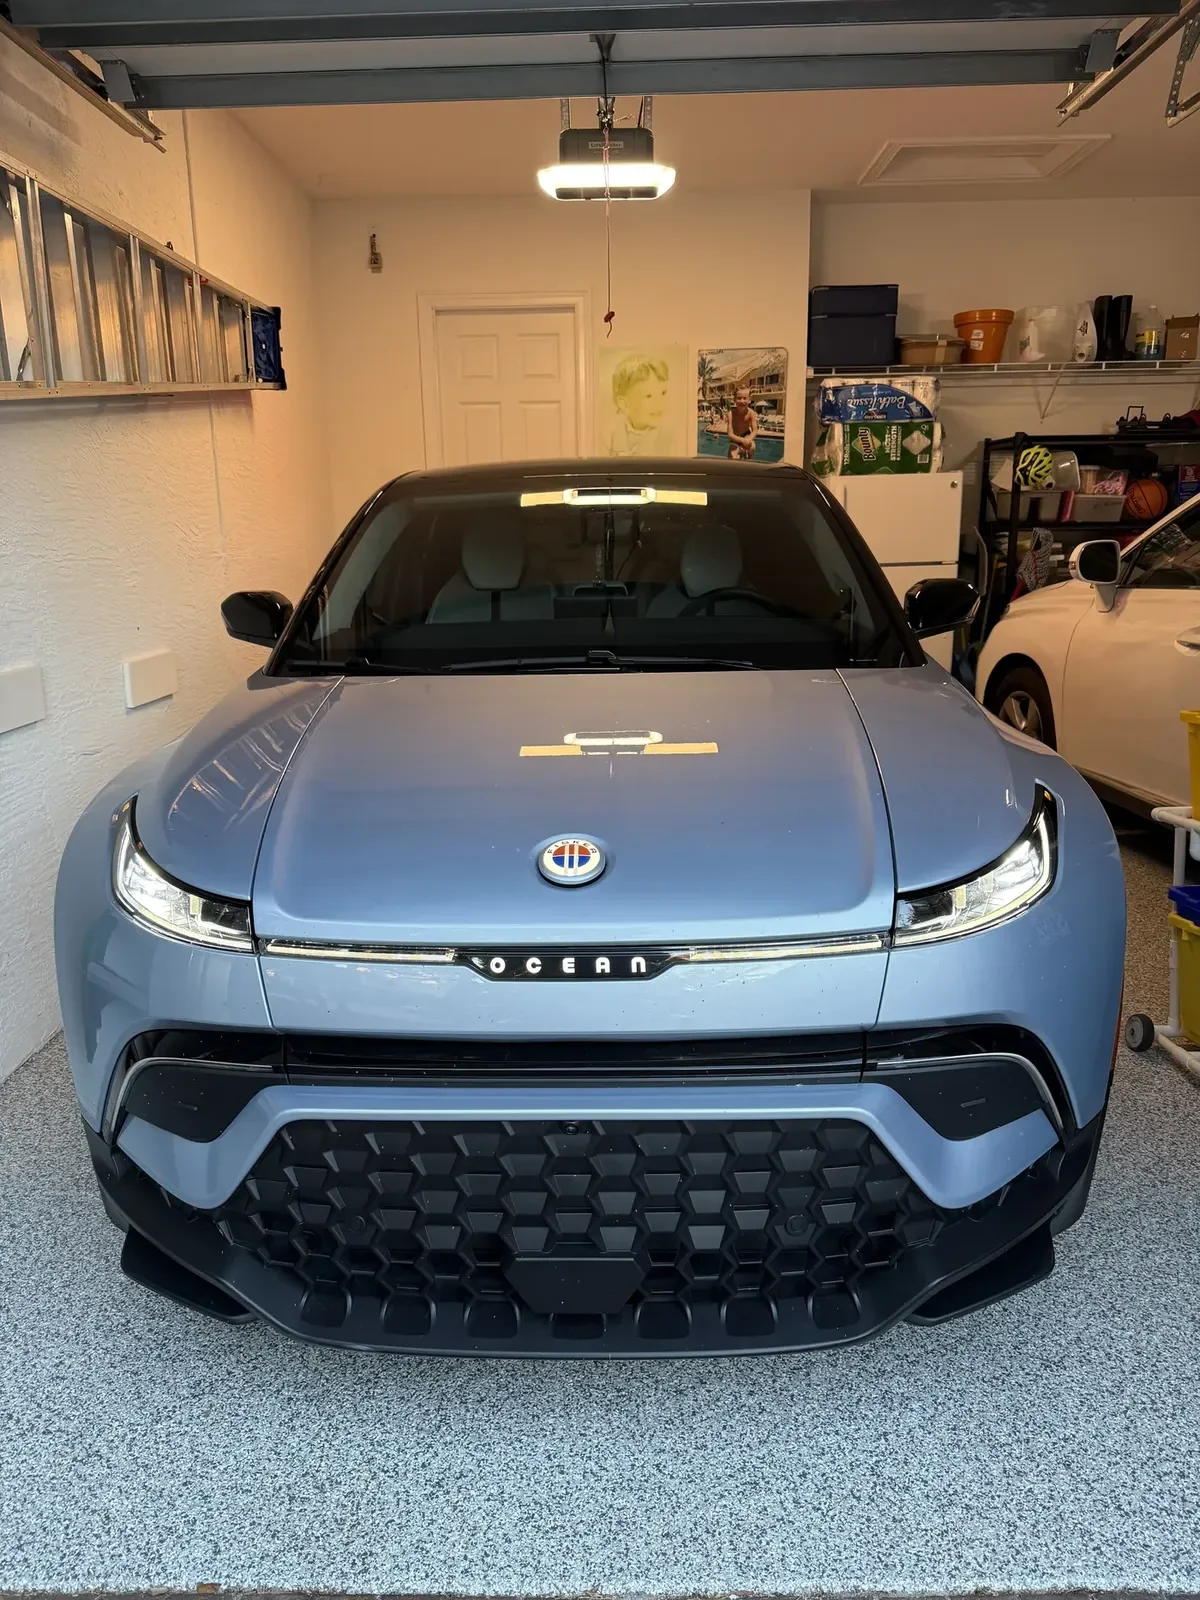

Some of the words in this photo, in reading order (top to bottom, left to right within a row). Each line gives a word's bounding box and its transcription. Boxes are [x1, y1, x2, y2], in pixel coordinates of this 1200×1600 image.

[877, 395, 906, 410] Bath
[858, 427, 877, 461] Bounty
[547, 840, 597, 854] FISKER
[489, 956, 647, 974] OCEAN
